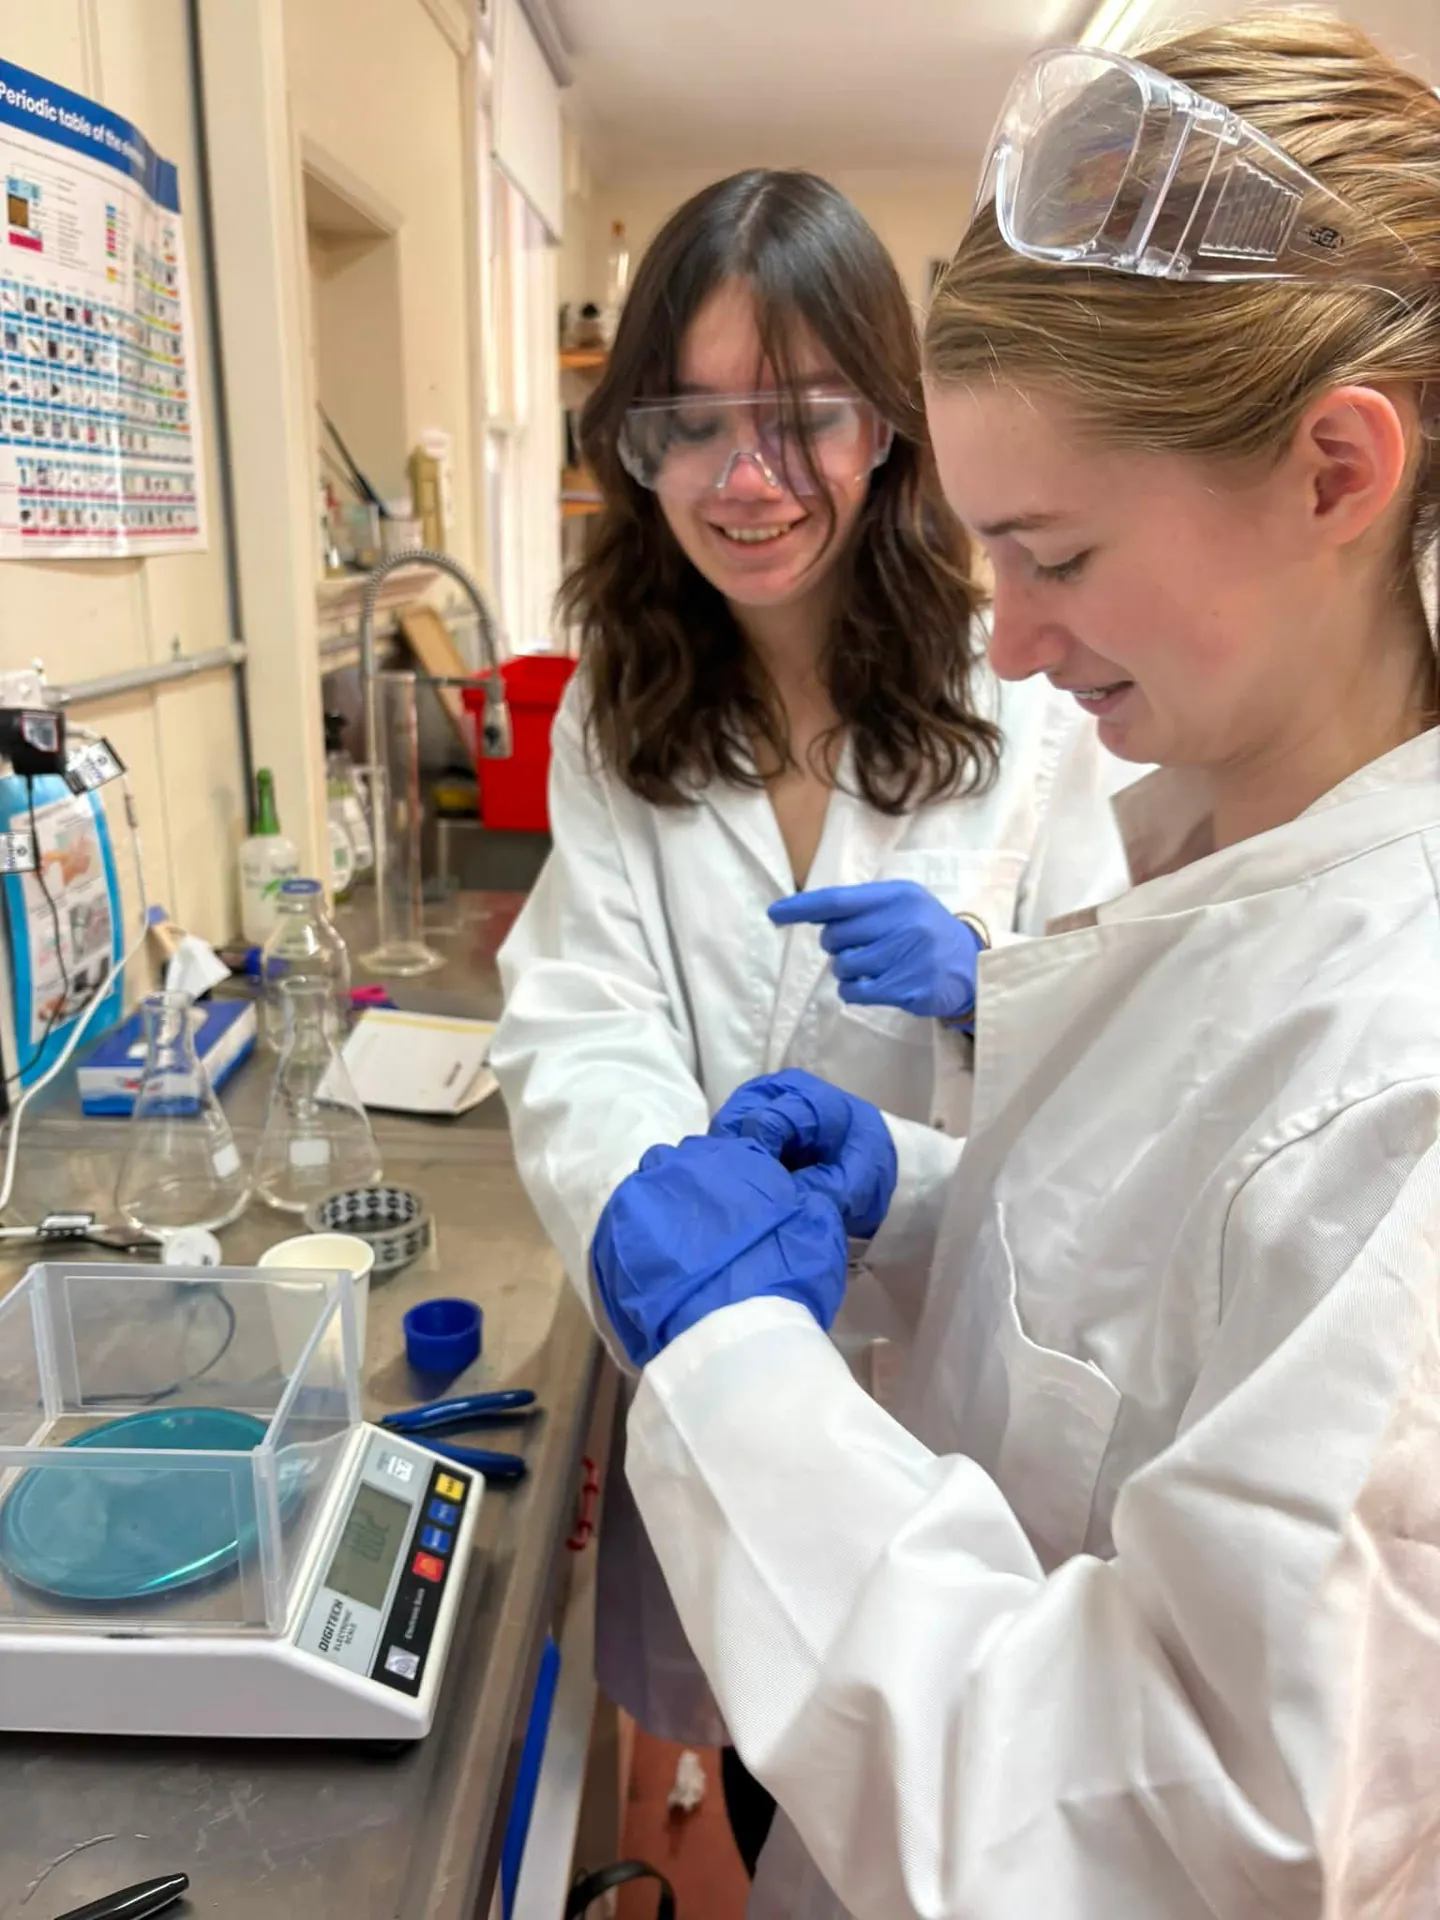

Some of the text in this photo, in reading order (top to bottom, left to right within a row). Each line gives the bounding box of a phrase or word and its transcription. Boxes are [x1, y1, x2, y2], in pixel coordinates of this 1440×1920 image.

[0, 81, 57, 122] Periodic
[58, 107, 91, 137] table
[92, 124, 104, 143] of
[318, 1599, 343, 1652] DIGITECH
